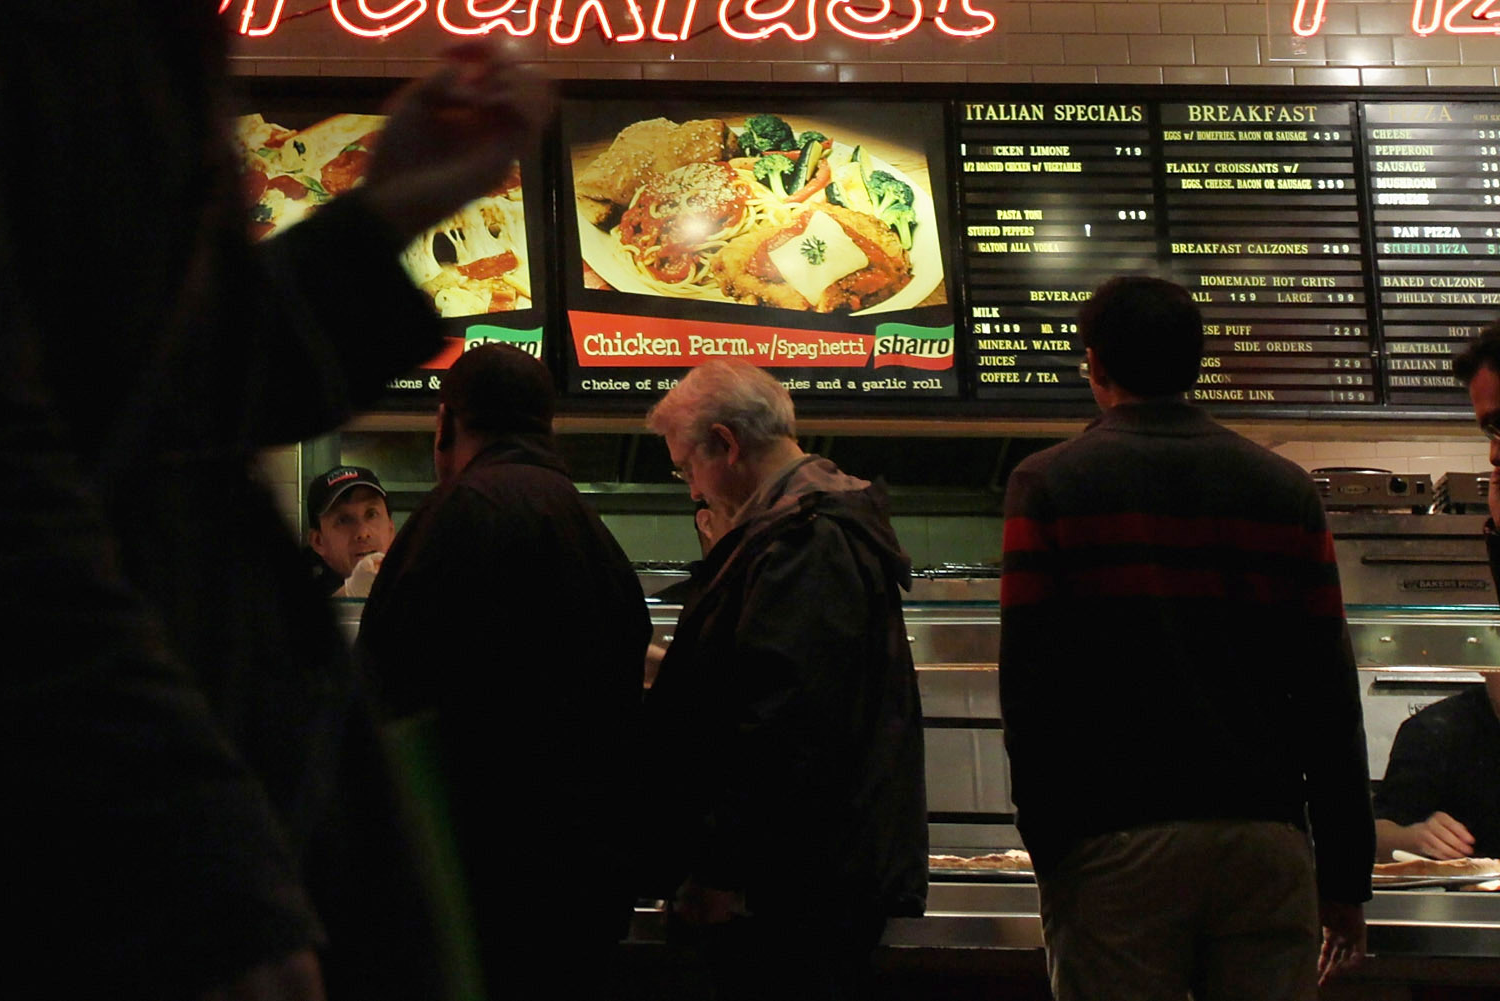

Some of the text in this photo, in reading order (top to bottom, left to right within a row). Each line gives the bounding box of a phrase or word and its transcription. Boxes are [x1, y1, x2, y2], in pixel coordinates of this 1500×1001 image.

[965, 104, 1143, 122] ITALIAN SPECIALS
[1188, 105, 1318, 122] BREAKFAST
[1163, 131, 1182, 141] EGGS
[1238, 131, 1262, 141] BACON
[1263, 131, 1274, 141] OR
[1275, 131, 1308, 142] SAUSAGE
[1372, 129, 1413, 140] CHEESE
[1030, 146, 1070, 157] LIMONE
[1375, 145, 1434, 156] PEPPERONI
[1166, 162, 1299, 174] FLAKLY CROISSANTS w/
[1376, 161, 1427, 173] SAUSAGE
[1237, 179, 1262, 190] BACON
[1264, 179, 1276, 190] OR
[1277, 179, 1313, 190] SAUSAGE
[1376, 178, 1437, 190] MUSHROOM
[996, 210, 1023, 221] PASTA
[967, 226, 1035, 237] STUFFED PEPPERS
[1392, 227, 1419, 238] PAN
[1423, 227, 1462, 238] PIZZA
[1010, 243, 1031, 253] ALLA
[1171, 243, 1242, 254] BREAKFAST
[1247, 244, 1309, 255] CALZONES
[1435, 244, 1469, 255] PIZZA
[1200, 276, 1336, 288] HOMEMADE HOT GRITS
[1383, 277, 1485, 288] BAKED CALZONE
[1277, 293, 1314, 303] LARGE
[1396, 293, 1435, 304] PHILLY
[1440, 293, 1476, 304] STEAK
[972, 307, 1000, 318] MILK
[1225, 325, 1252, 336] PUFF
[1448, 327, 1471, 337] HOT
[583, 332, 682, 356] Chicken
[688, 335, 754, 356] Parm.
[878, 334, 950, 355] sbarro
[978, 340, 1071, 351] MINERAL WATER
[1234, 342, 1313, 352] SIDE ORDERS
[1393, 343, 1451, 353] MEATBALL
[978, 355, 1016, 366] JUICES
[1391, 359, 1436, 370] ITALIAN
[428, 375, 441, 390] &
[980, 372, 1020, 383] COFFEE
[1036, 372, 1059, 383] TEA
[1390, 376, 1455, 387] ITALIAN SAUSAGE
[581, 379, 630, 390] Choice
[636, 379, 652, 390] of
[816, 379, 842, 390] and
[847, 380, 857, 389] a
[862, 379, 906, 392] garlic
[913, 379, 943, 390] roll
[1194, 390, 1244, 400] SAUSAGE
[1249, 390, 1275, 401] LINK
